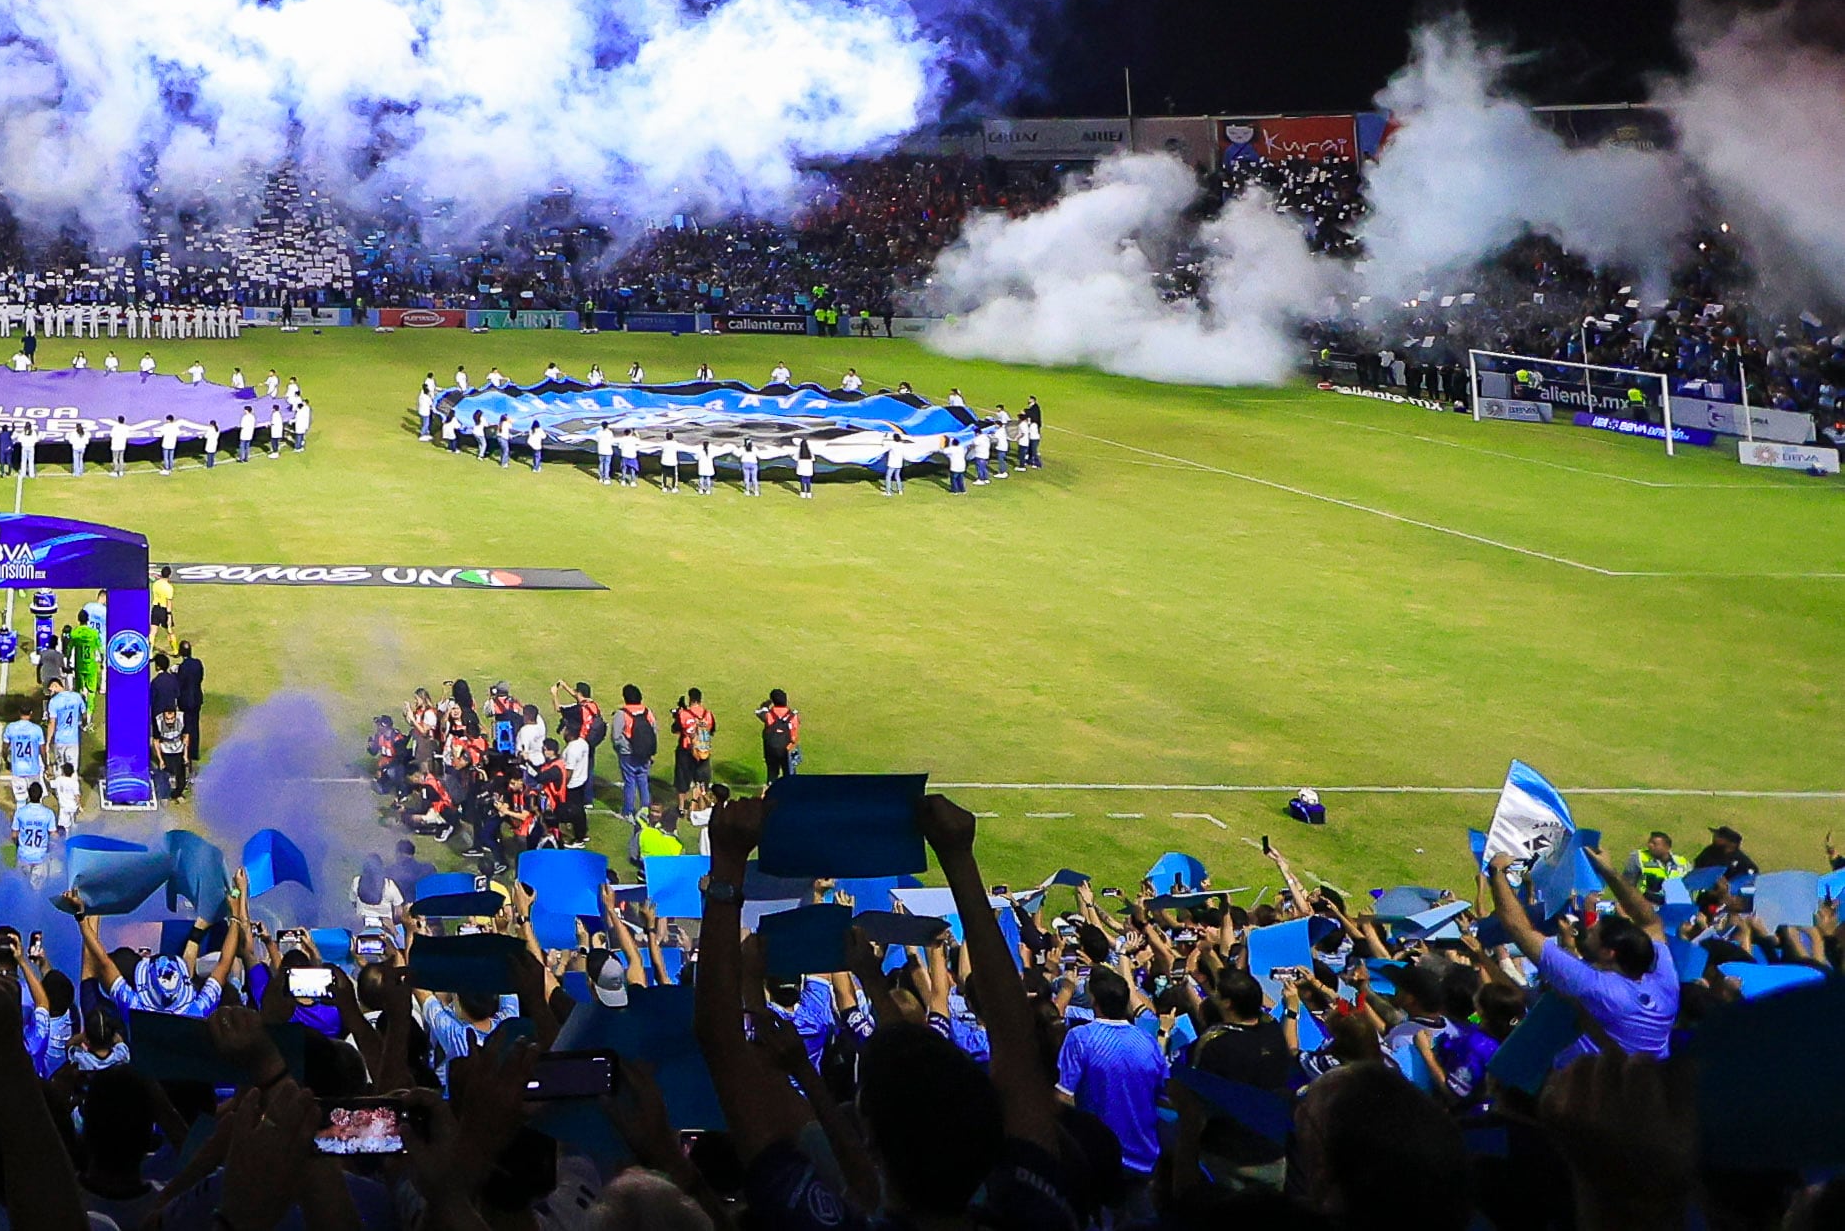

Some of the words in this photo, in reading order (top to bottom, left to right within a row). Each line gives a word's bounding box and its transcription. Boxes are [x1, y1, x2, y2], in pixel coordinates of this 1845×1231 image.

[1264, 129, 1347, 154] Kurai
[728, 319, 805, 331] caliente.mx
[1541, 384, 1630, 410] aliente.mx
[177, 565, 372, 582] SOMOS
[65, 712, 73, 727] 4
[16, 741, 32, 758] 24
[25, 829, 43, 848] 26
